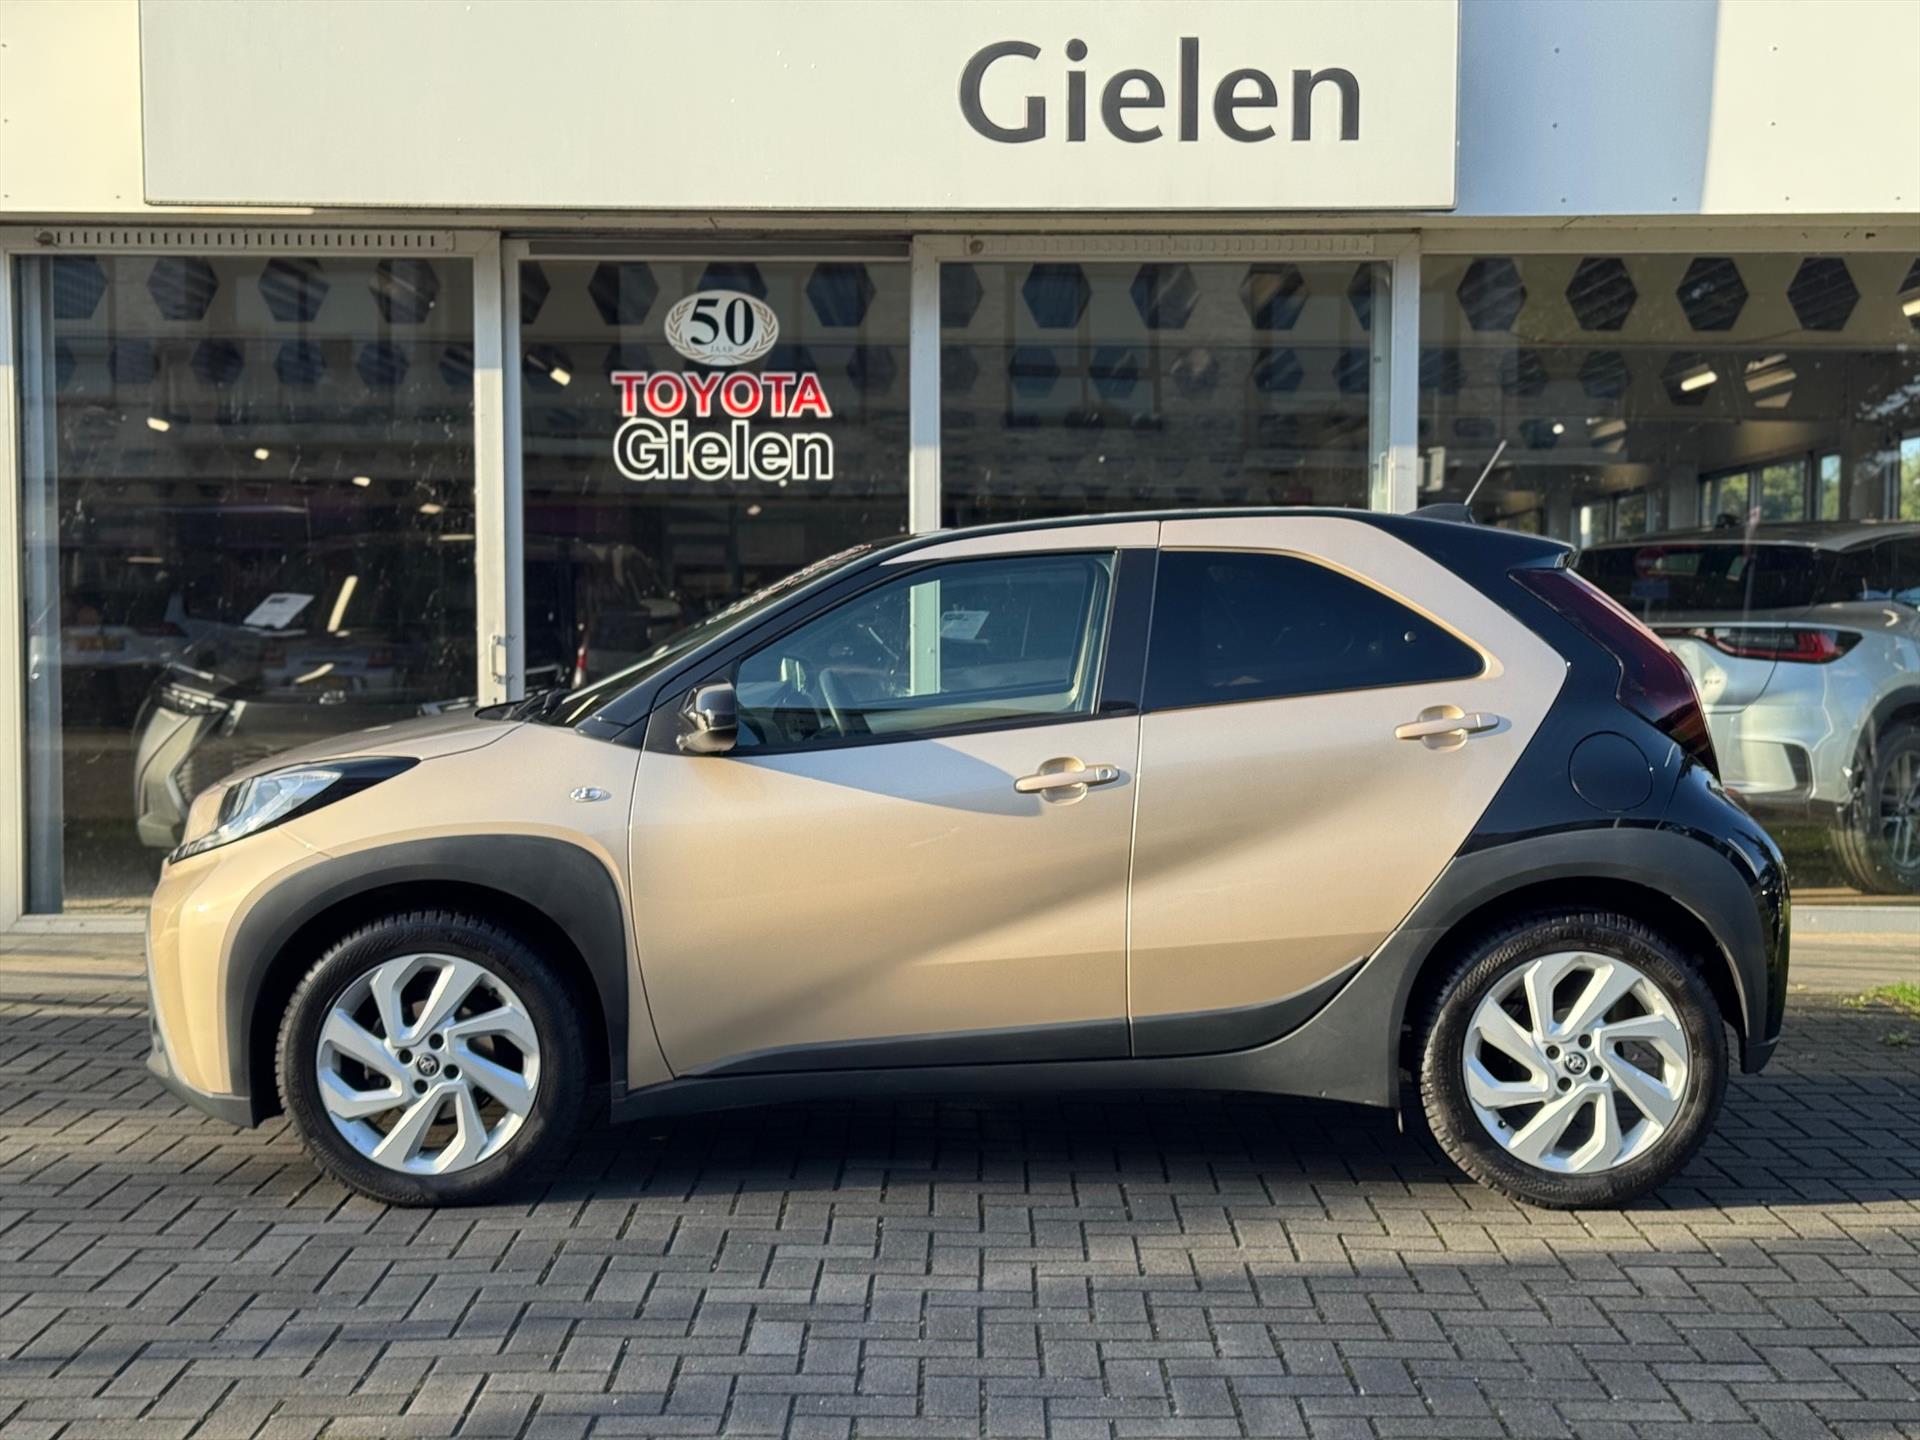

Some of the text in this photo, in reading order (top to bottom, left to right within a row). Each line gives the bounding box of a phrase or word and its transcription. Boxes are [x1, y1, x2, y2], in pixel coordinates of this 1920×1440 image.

[959, 37, 1360, 143] Gielen
[690, 297, 755, 346] 50
[611, 371, 832, 418] TOYOTA
[613, 418, 834, 481] Gielen
